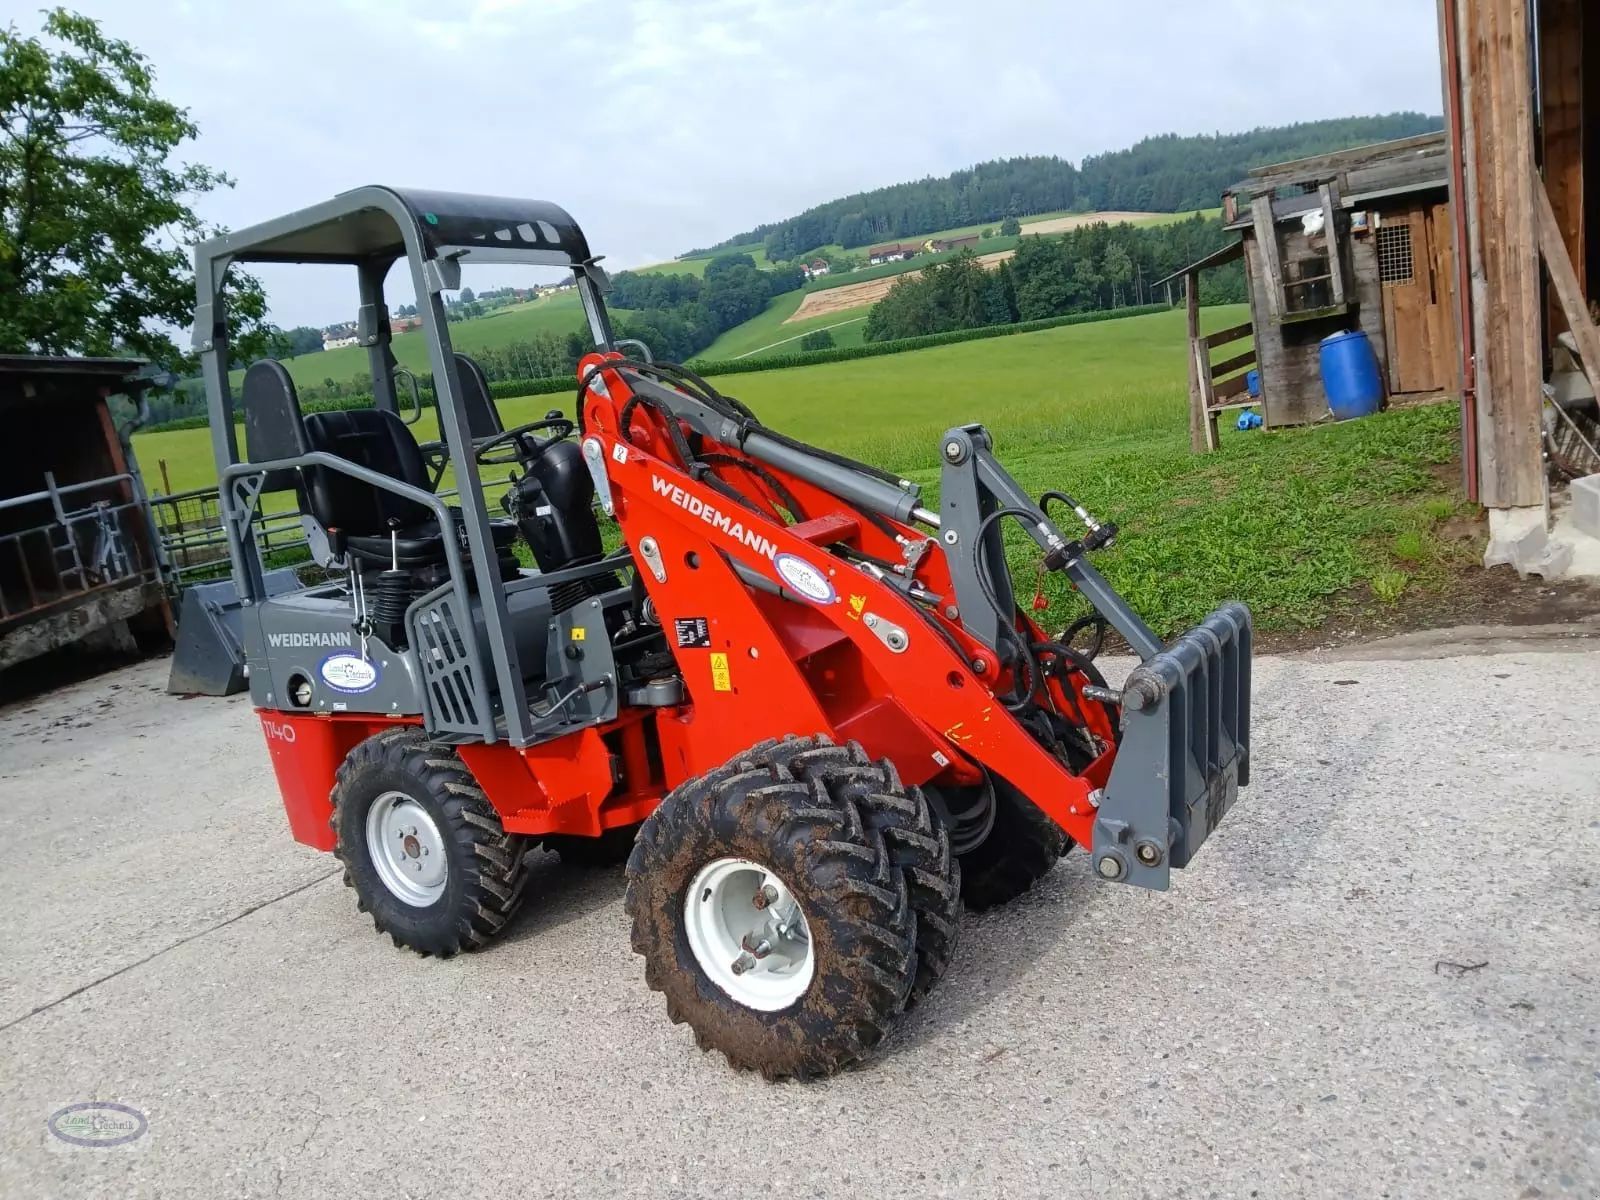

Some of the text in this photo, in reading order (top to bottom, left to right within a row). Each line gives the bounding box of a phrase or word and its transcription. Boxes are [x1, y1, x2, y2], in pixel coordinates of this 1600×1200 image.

[652, 475, 777, 560] WEIDEMANN
[268, 632, 351, 647] WEIDEMANN
[264, 720, 295, 742] 1140
